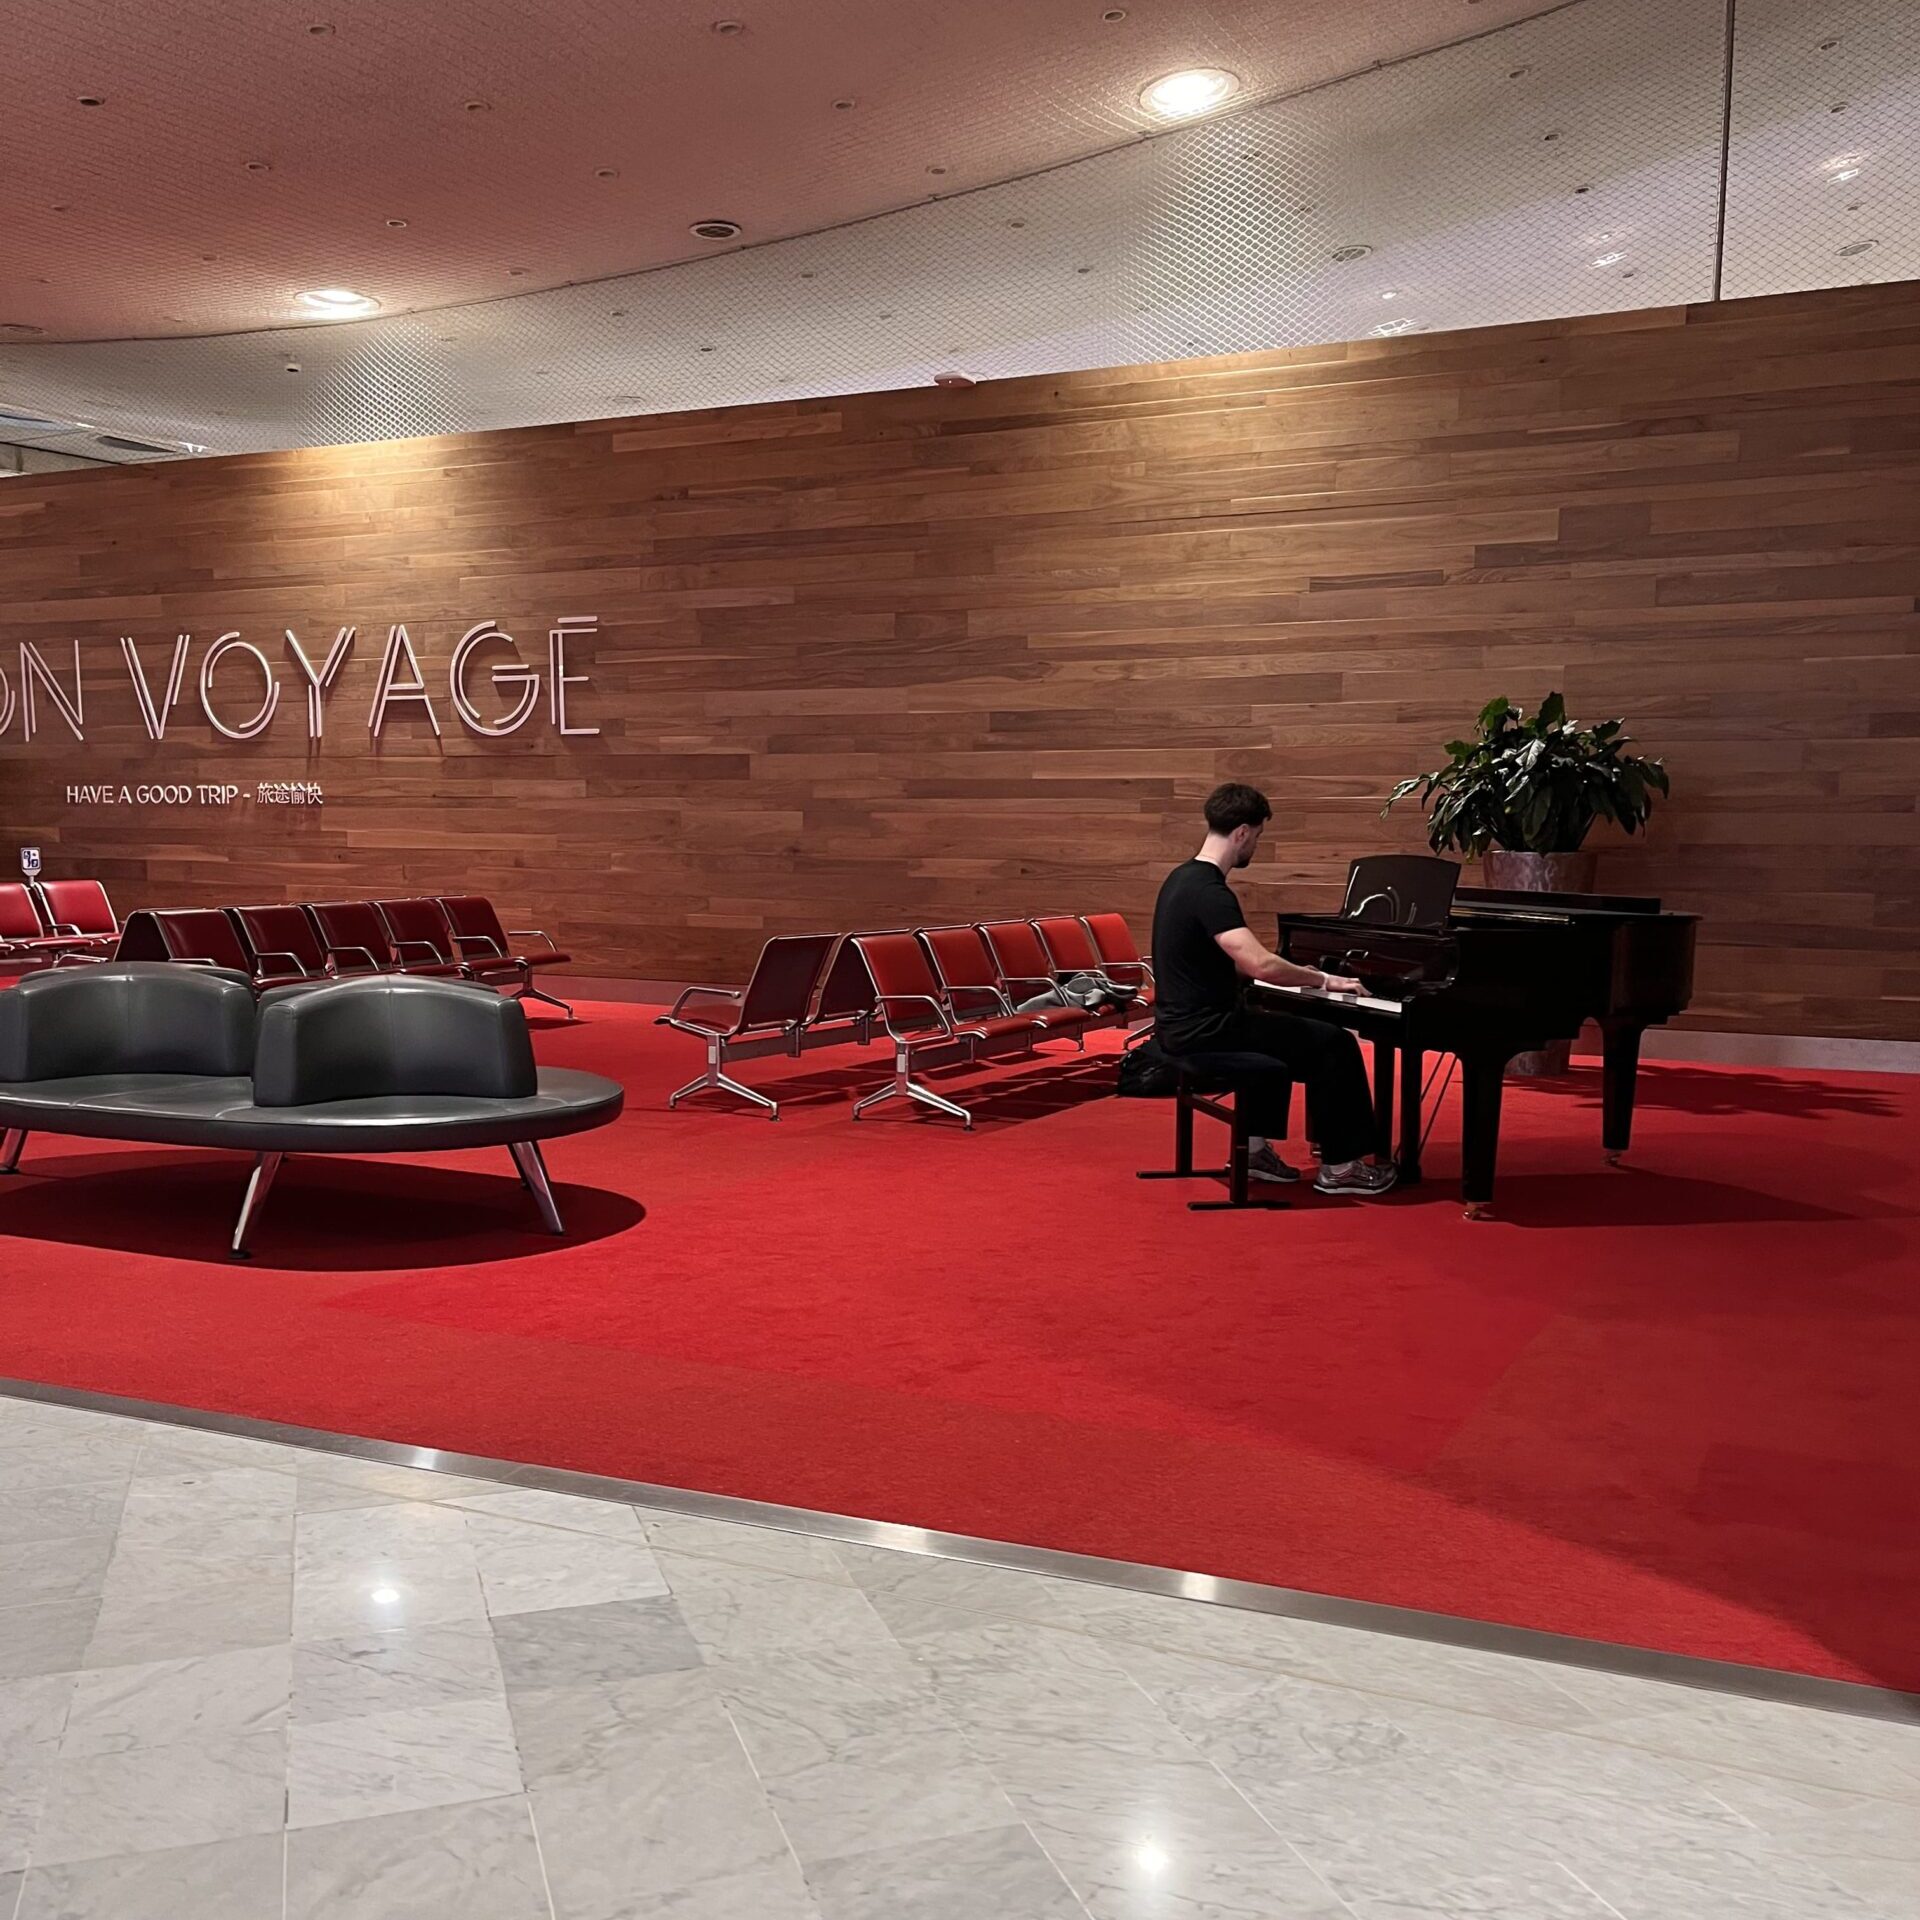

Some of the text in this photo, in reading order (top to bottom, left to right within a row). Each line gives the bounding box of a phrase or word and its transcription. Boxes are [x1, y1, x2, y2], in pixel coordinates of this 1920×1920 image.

[0, 616, 600, 742] N VOYAGE
[66, 785, 113, 804] HAVE
[117, 785, 132, 804] A
[137, 784, 192, 804] GOOD
[196, 784, 238, 804] TRIP
[257, 782, 323, 804] 旅途愉快
